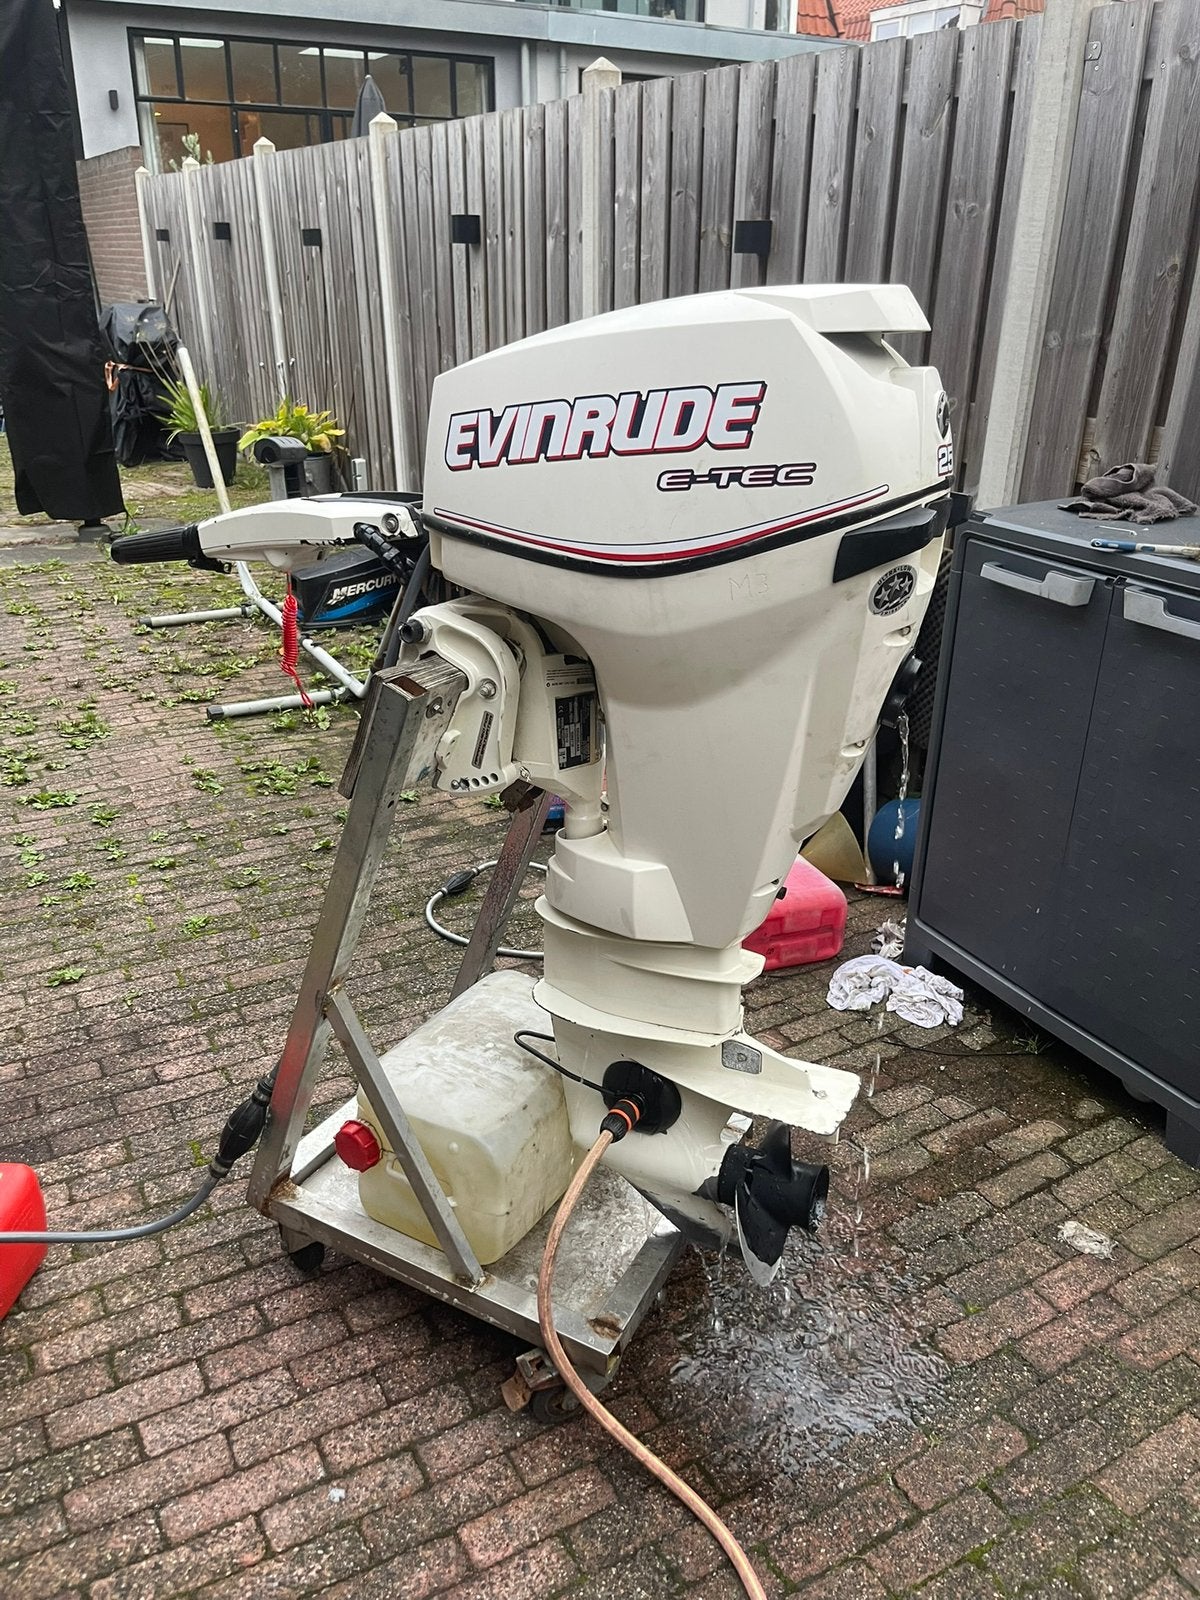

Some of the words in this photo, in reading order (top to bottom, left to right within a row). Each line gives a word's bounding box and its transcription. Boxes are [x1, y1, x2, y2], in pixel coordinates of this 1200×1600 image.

[445, 381, 767, 472] EVINRUDE
[656, 463, 817, 492] E-TEC
[327, 573, 398, 605] MERCURY
